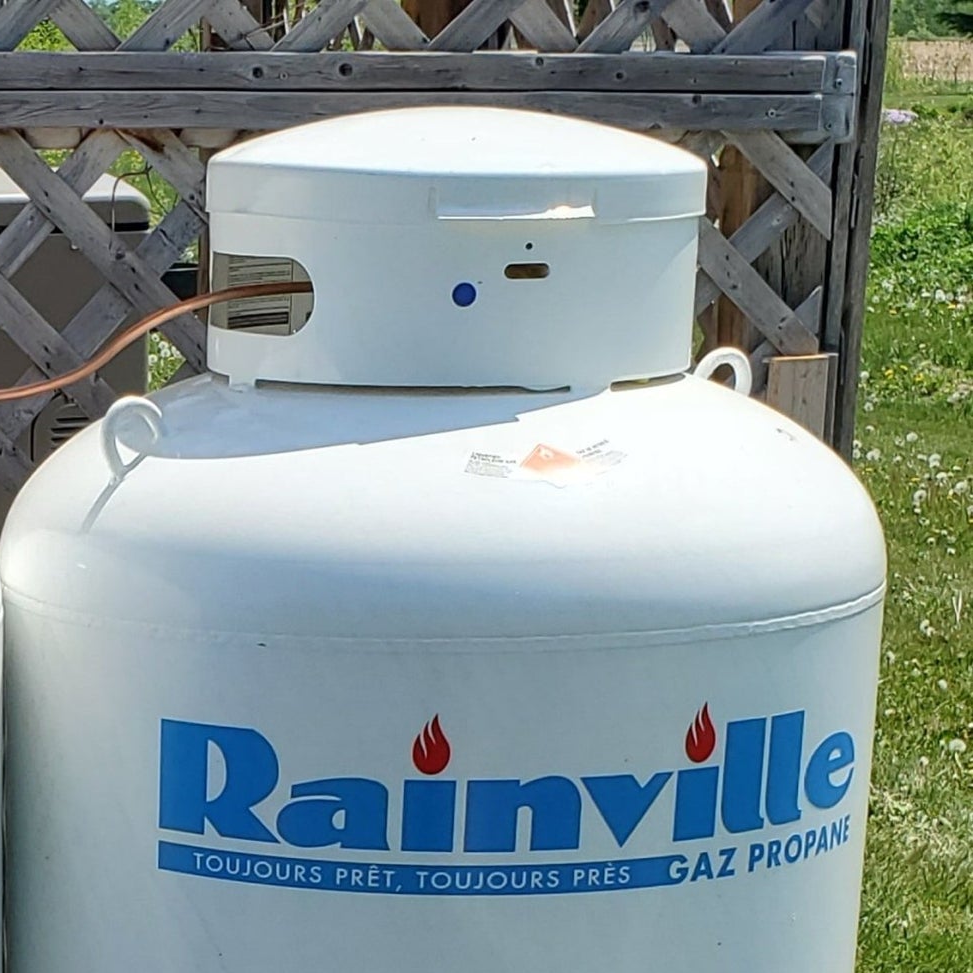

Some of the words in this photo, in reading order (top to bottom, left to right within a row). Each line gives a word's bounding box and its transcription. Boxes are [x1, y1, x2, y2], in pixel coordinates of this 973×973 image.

[158, 701, 855, 853] Rainville
[192, 853, 322, 882] TOUJOURS
[336, 865, 401, 891] PRÊT,
[416, 868, 560, 890] TOUJOURS
[573, 864, 631, 887] PRÈS
[669, 847, 737, 882] GAZ
[747, 814, 851, 873] PROPANE
